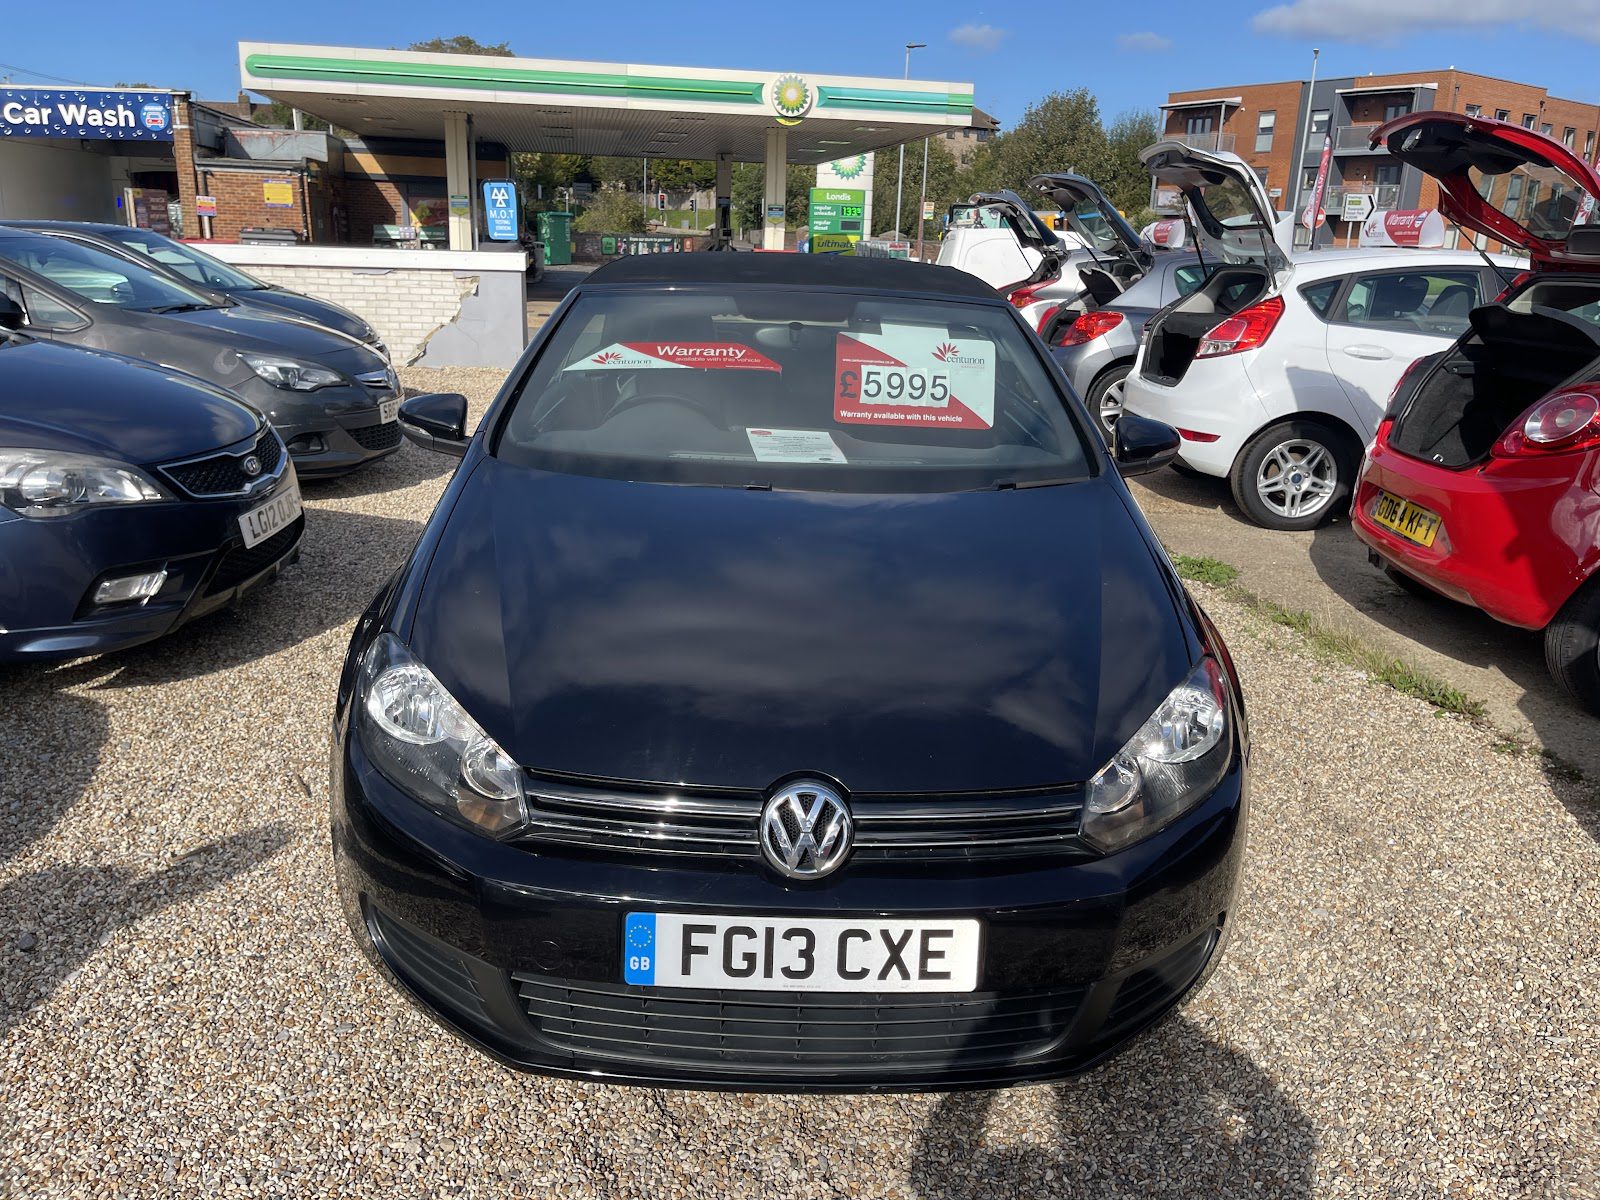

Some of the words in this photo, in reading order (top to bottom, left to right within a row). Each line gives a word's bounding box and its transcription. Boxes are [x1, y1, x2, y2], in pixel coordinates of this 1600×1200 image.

[3, 102, 51, 125] Car
[57, 103, 136, 127] Wash
[490, 210, 514, 219] M.O.T
[1387, 214, 1417, 228] Warranty
[657, 346, 746, 358] Warranty
[946, 354, 985, 365] centurion
[840, 410, 872, 419] Warranty
[873, 412, 905, 420] available
[906, 413, 922, 421] with
[923, 414, 937, 422] this
[937, 415, 963, 423] vehicle
[1405, 509, 1437, 540] KFT
[681, 923, 816, 979] FG13
[836, 928, 954, 981] CXE
[629, 956, 650, 971] GB
